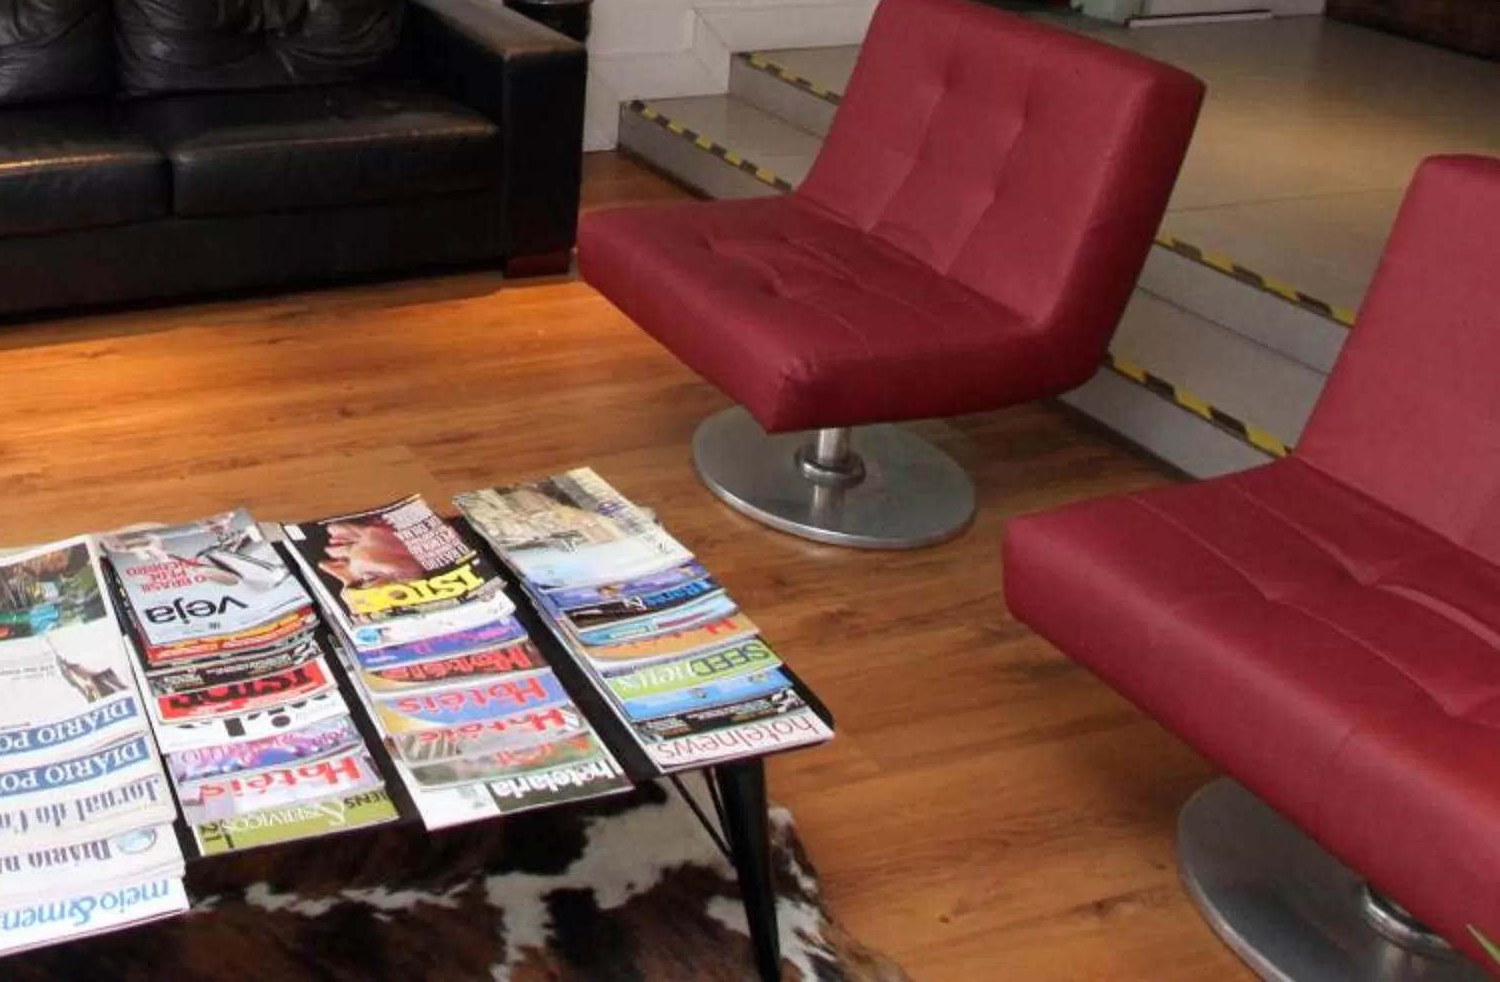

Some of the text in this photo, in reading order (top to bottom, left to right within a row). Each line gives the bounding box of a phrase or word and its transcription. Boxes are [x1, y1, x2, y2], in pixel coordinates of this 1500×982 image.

[146, 595, 248, 625] veja
[396, 677, 547, 715] Hotéis
[40, 700, 130, 742] DIÁRIO
[45, 744, 141, 783] DIÁRIO
[201, 758, 361, 798] Hotéis
[491, 760, 612, 798] hotelaria
[36, 802, 68, 827] do
[78, 778, 161, 822] Jornal
